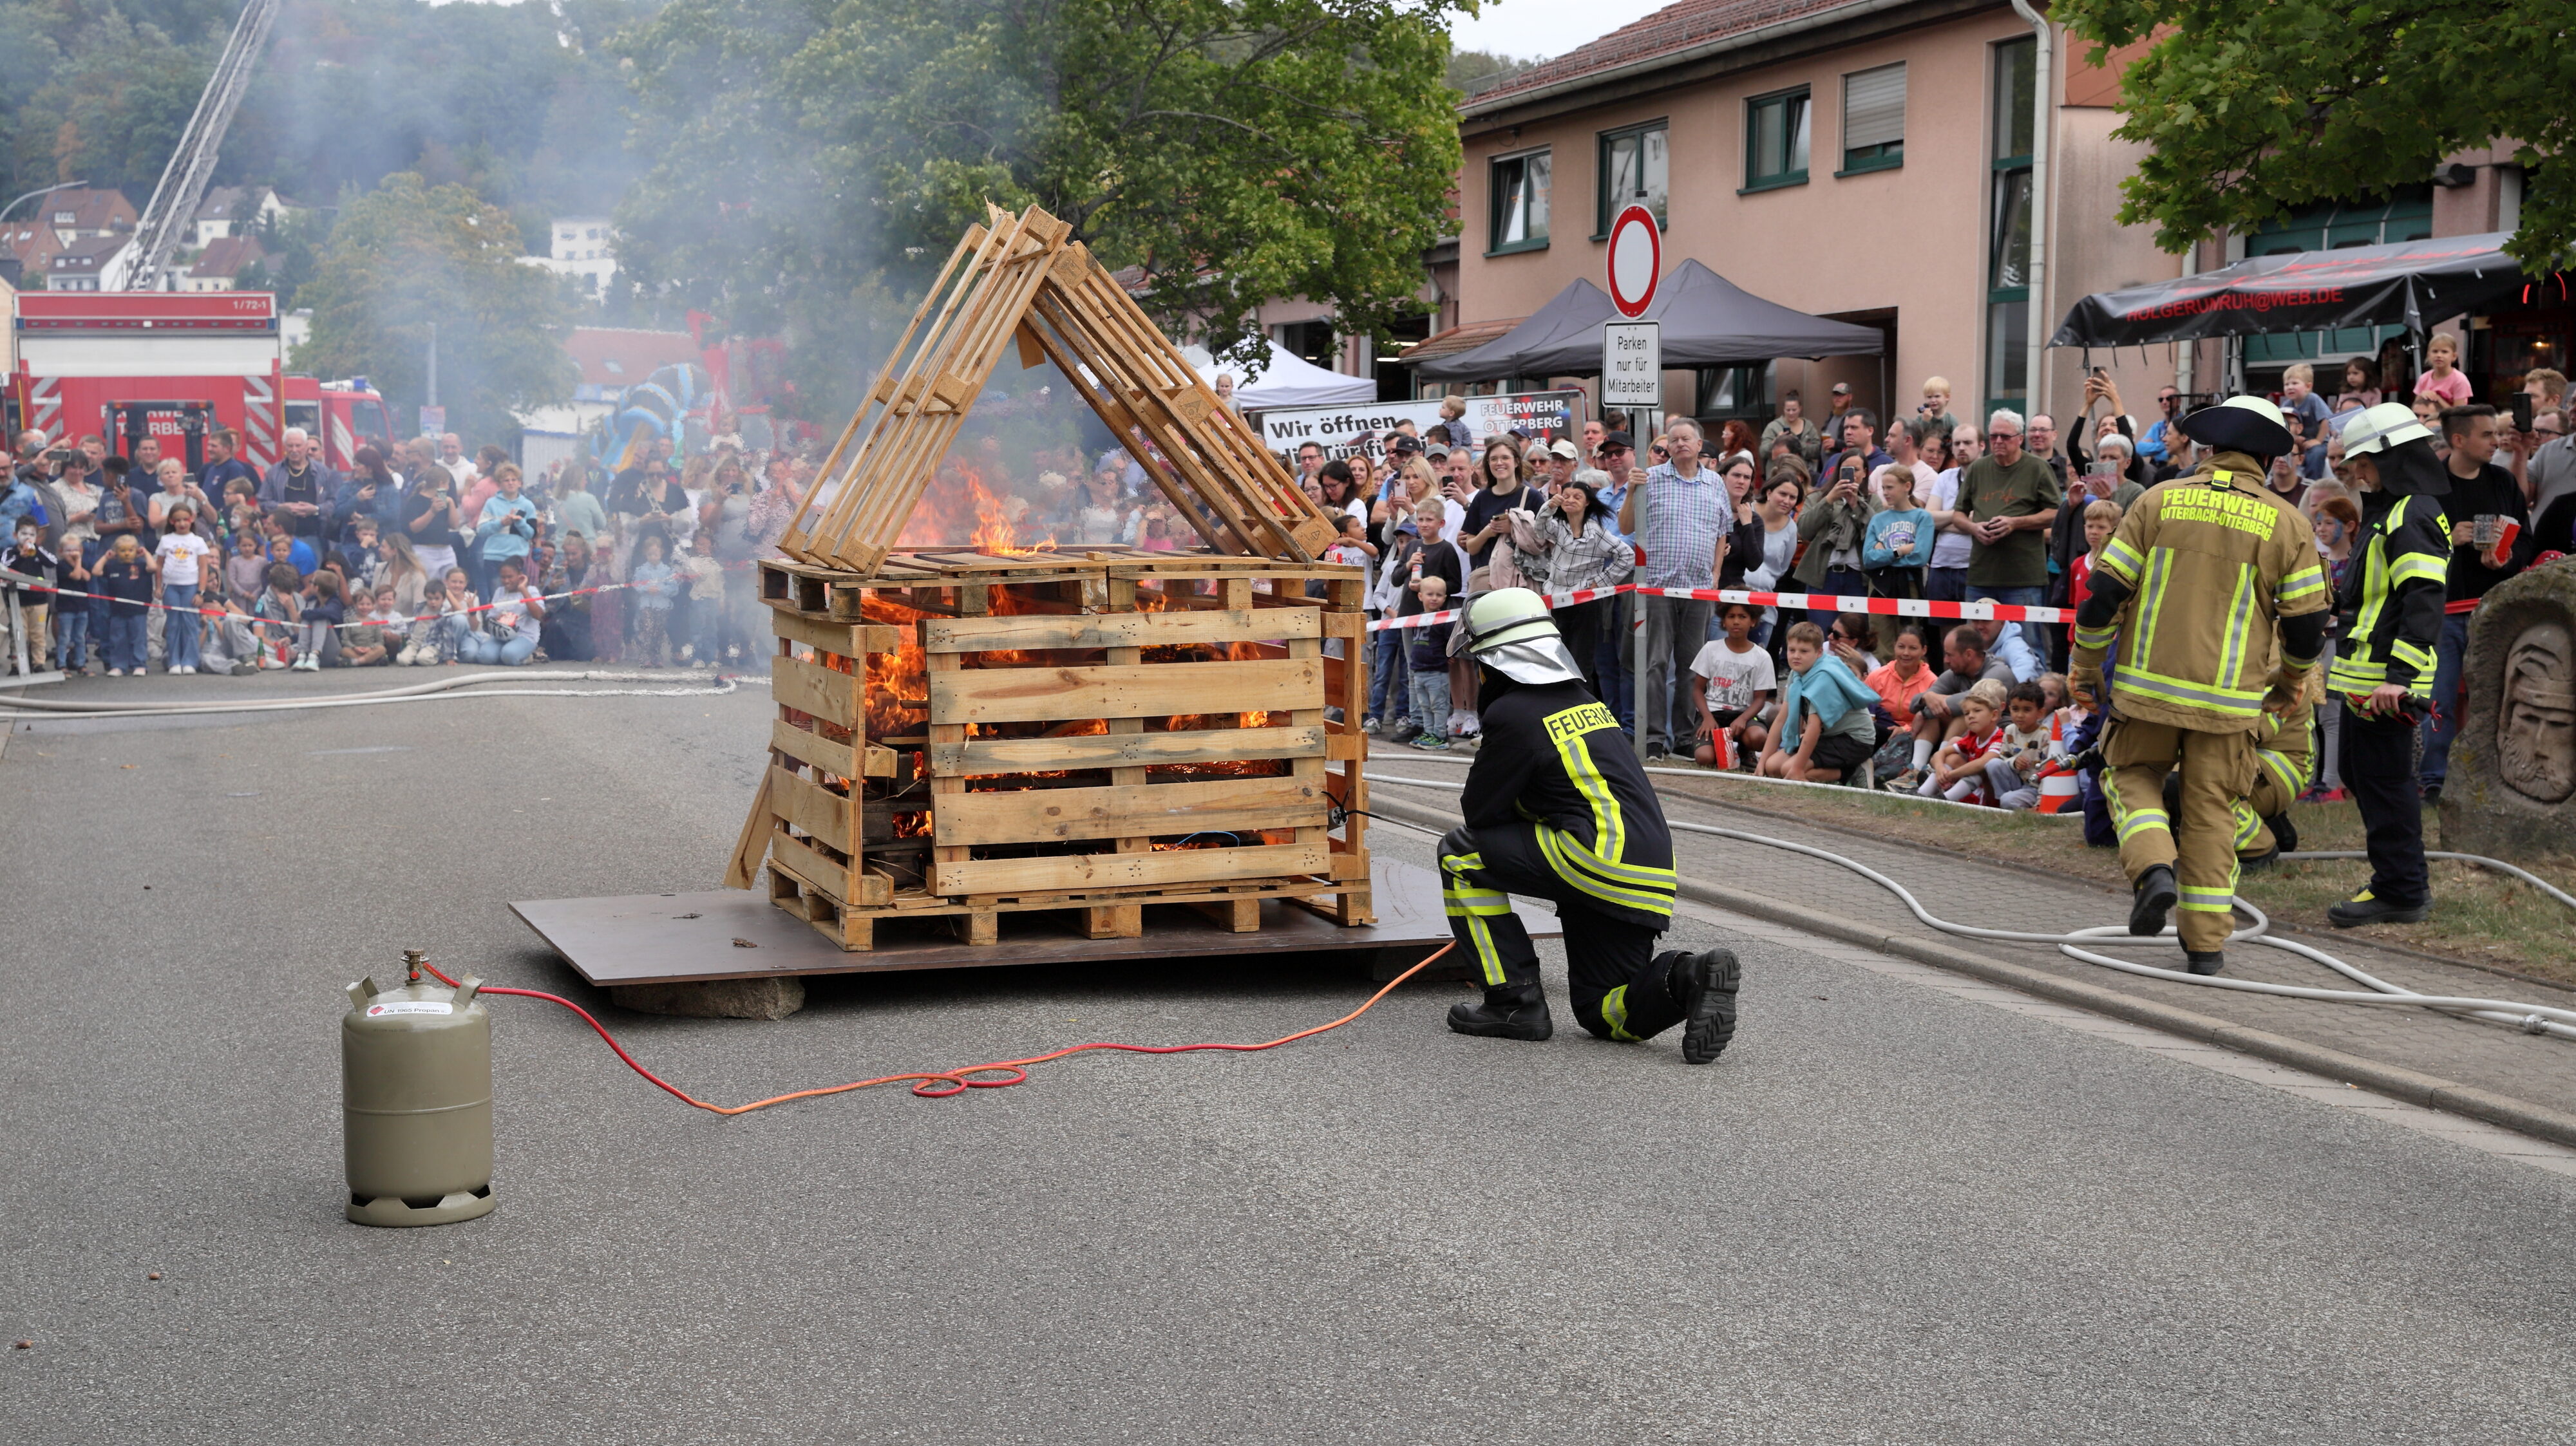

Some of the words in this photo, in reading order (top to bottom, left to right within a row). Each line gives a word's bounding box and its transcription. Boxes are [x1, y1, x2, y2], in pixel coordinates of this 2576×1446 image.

[1617, 335, 1647, 351] Parken
[1616, 360, 1632, 372] nur
[1635, 357, 1648, 372] für
[1607, 379, 1656, 394] Mitarbeiter
[1481, 400, 1564, 417] FEUERWEHR
[1270, 420, 1312, 439] Wir
[1320, 415, 1396, 435] öffnen
[2163, 487, 2279, 528] FEUERWEHR
[2160, 505, 2274, 542] OTTERBACH-OTTERBERG
